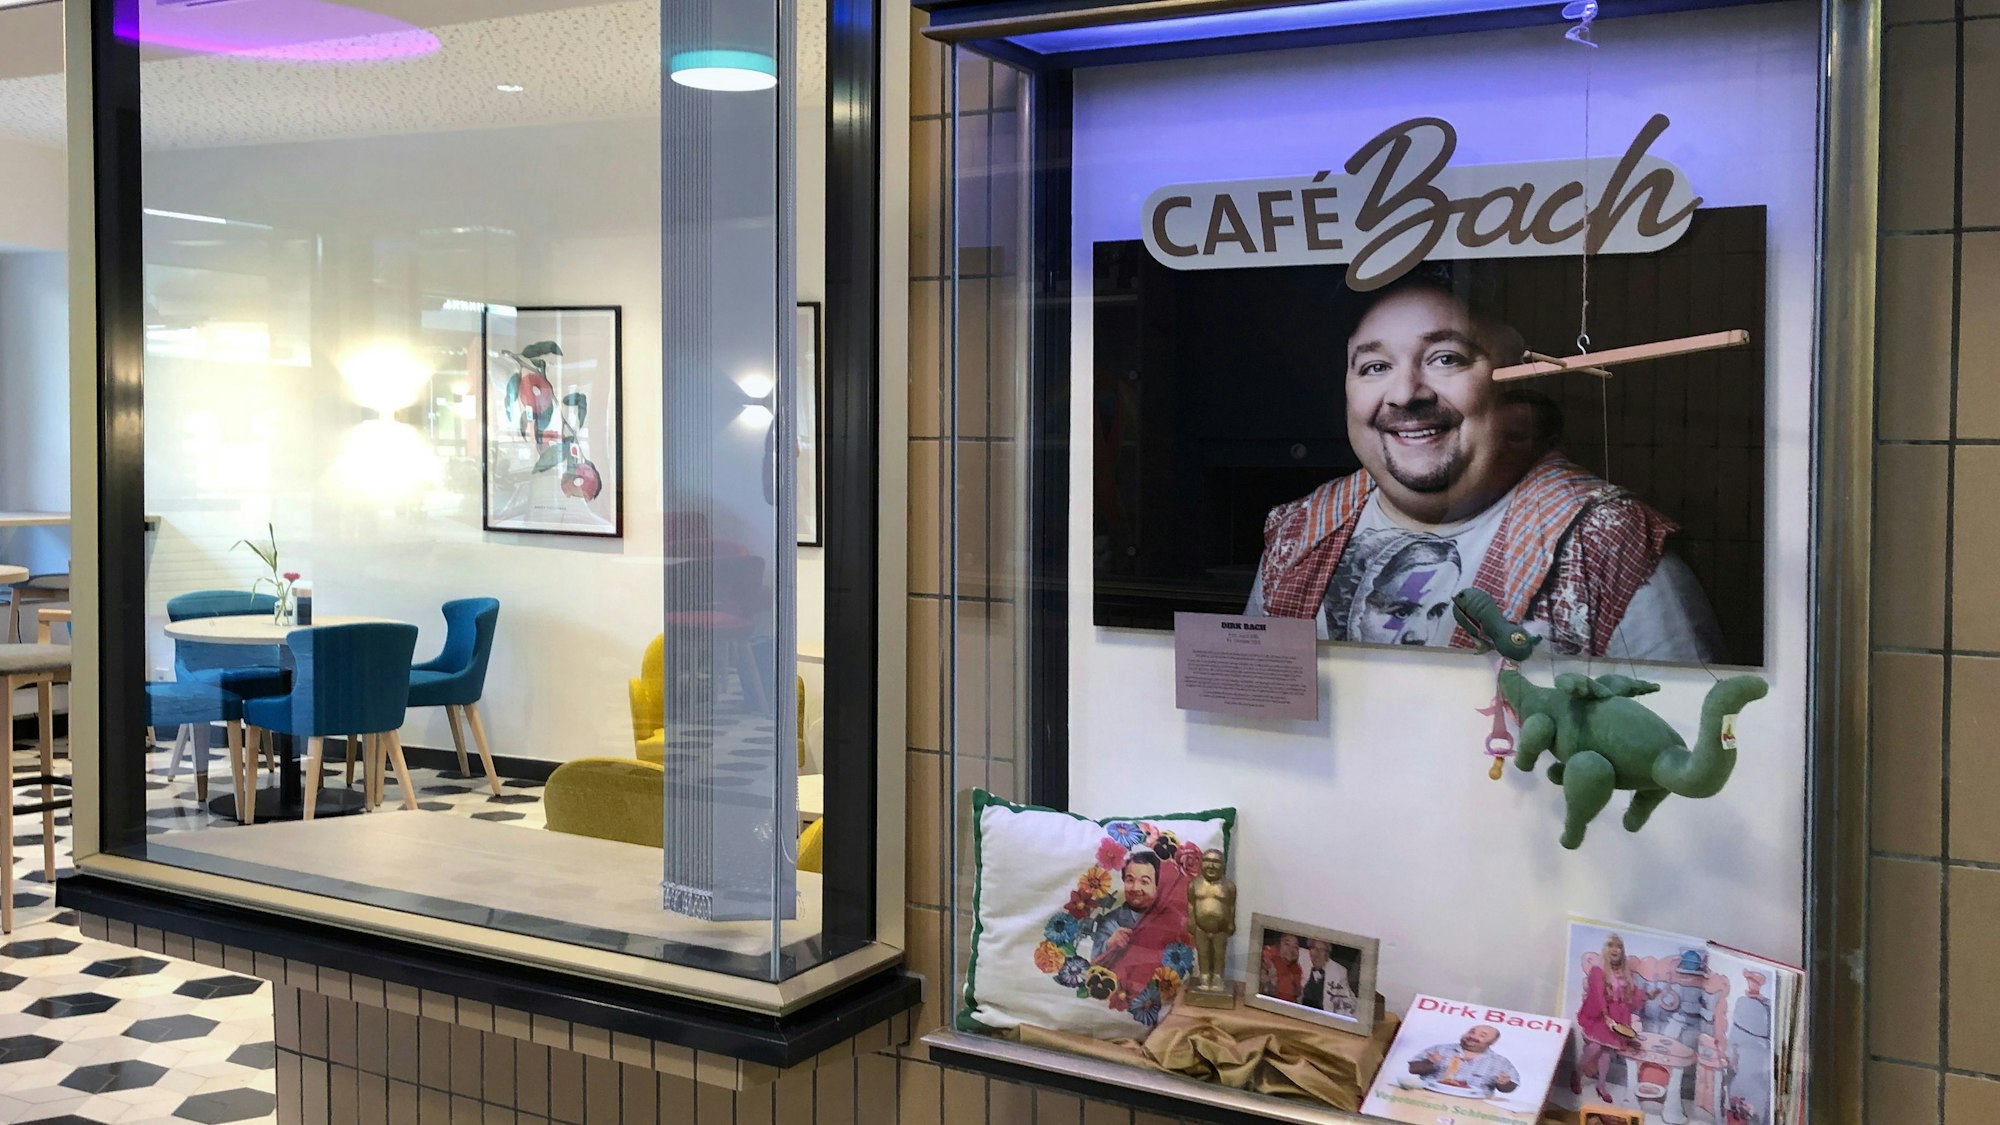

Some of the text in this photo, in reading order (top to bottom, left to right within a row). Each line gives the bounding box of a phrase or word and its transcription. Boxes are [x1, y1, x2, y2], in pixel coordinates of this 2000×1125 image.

[1151, 113, 1704, 292] CAFÉ Bach
[1221, 621, 1267, 631] DIRK BACH
[1416, 997, 1564, 1033] Dirk Bach
